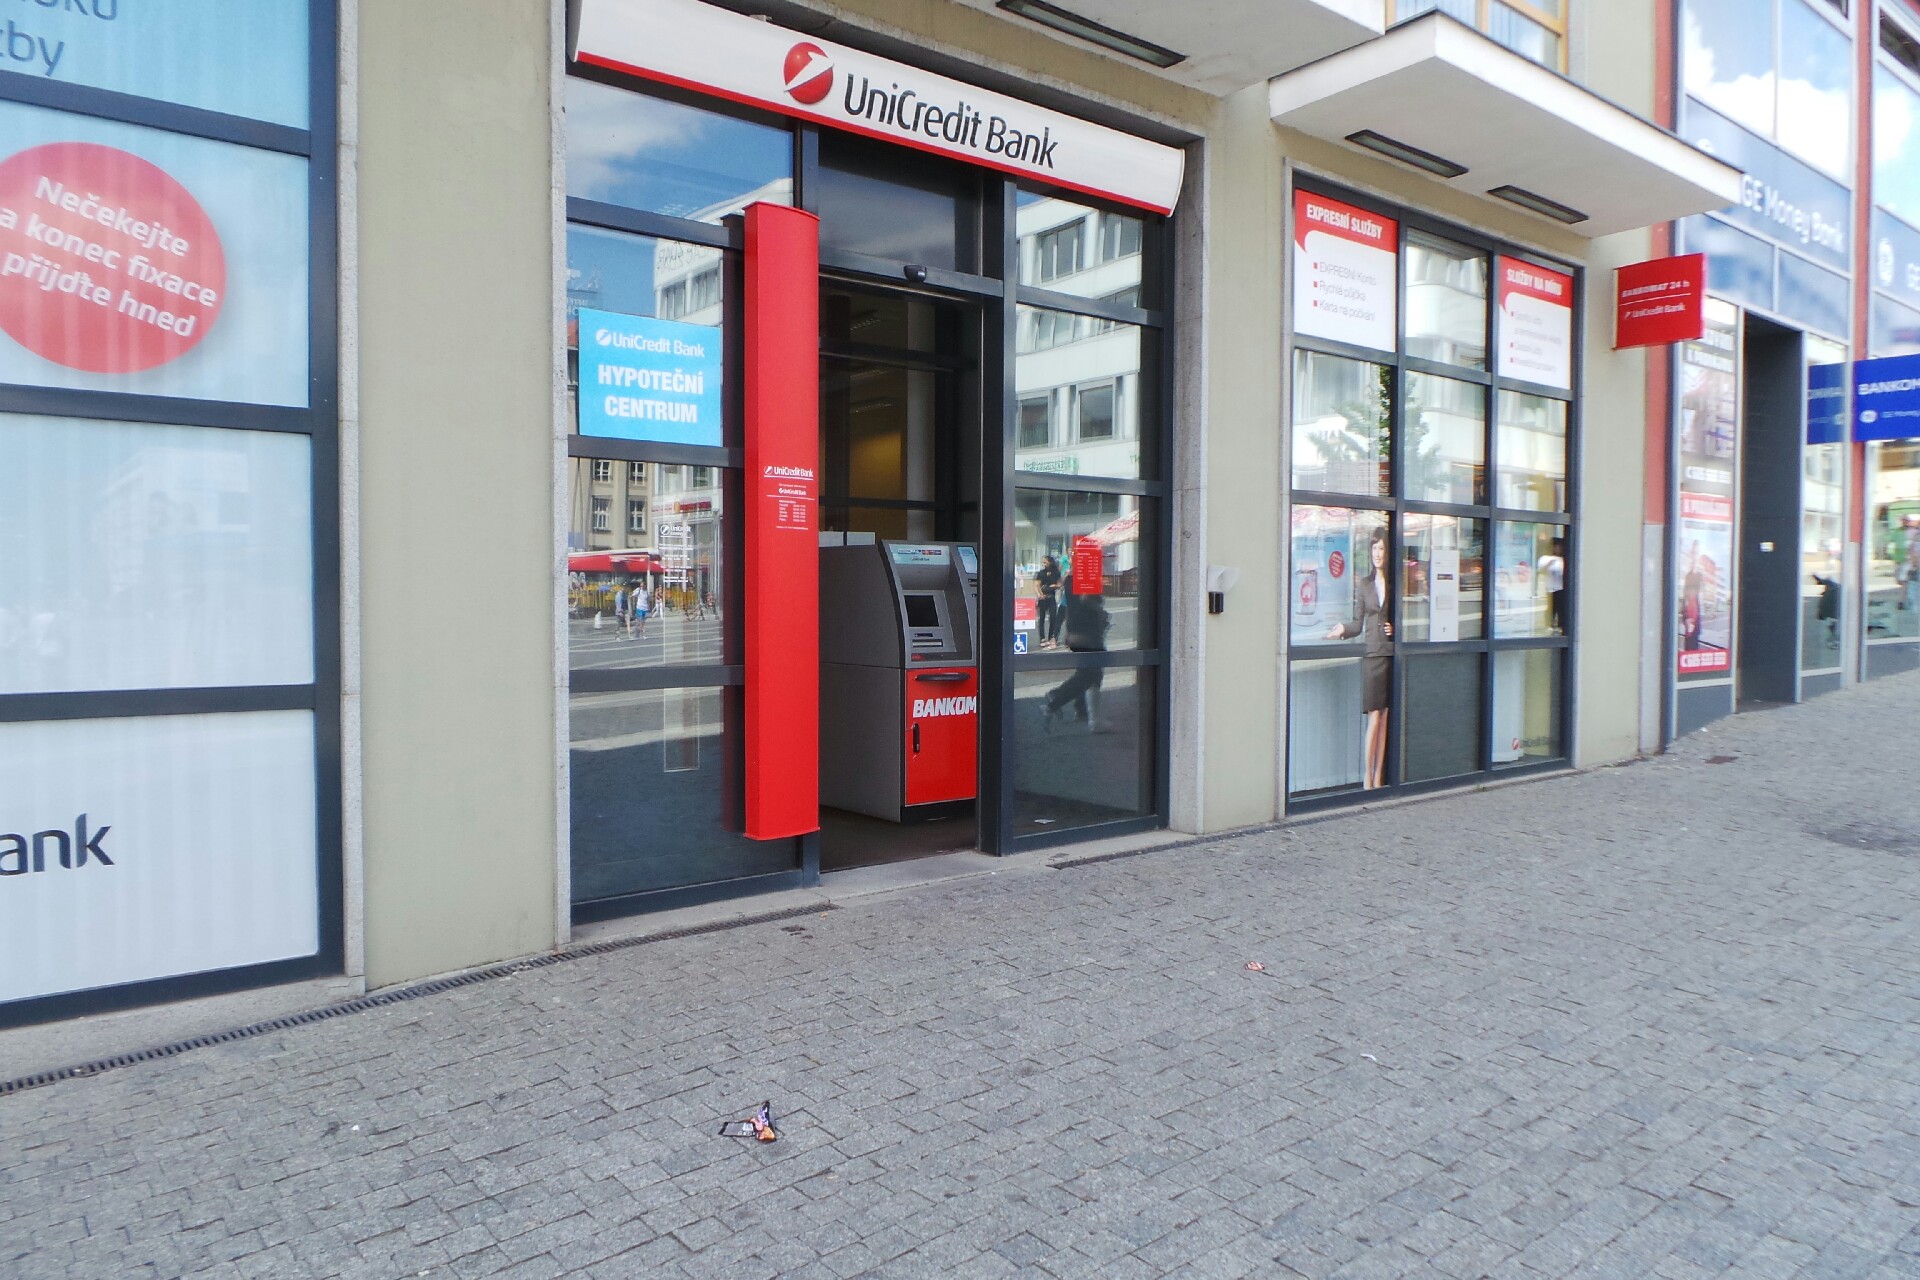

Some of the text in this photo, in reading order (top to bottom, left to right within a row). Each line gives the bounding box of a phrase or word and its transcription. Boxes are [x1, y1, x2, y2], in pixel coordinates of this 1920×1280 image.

[0, 20, 65, 77] by
[843, 72, 1058, 169] UniCredit Bank
[1742, 174, 1763, 213] GE
[35, 176, 190, 257] Nečekejte
[1306, 203, 1383, 240] EXPRESNÍ SLUŽBY
[25, 213, 121, 270] konec
[127, 254, 217, 307] fixace
[0, 252, 197, 338] přijďte hned
[613, 332, 705, 358] UniCredit Bank
[598, 364, 704, 395] HYPOTEČNÍ
[604, 395, 698, 423] CENTRUM
[774, 466, 814, 478] UniCredit Bank
